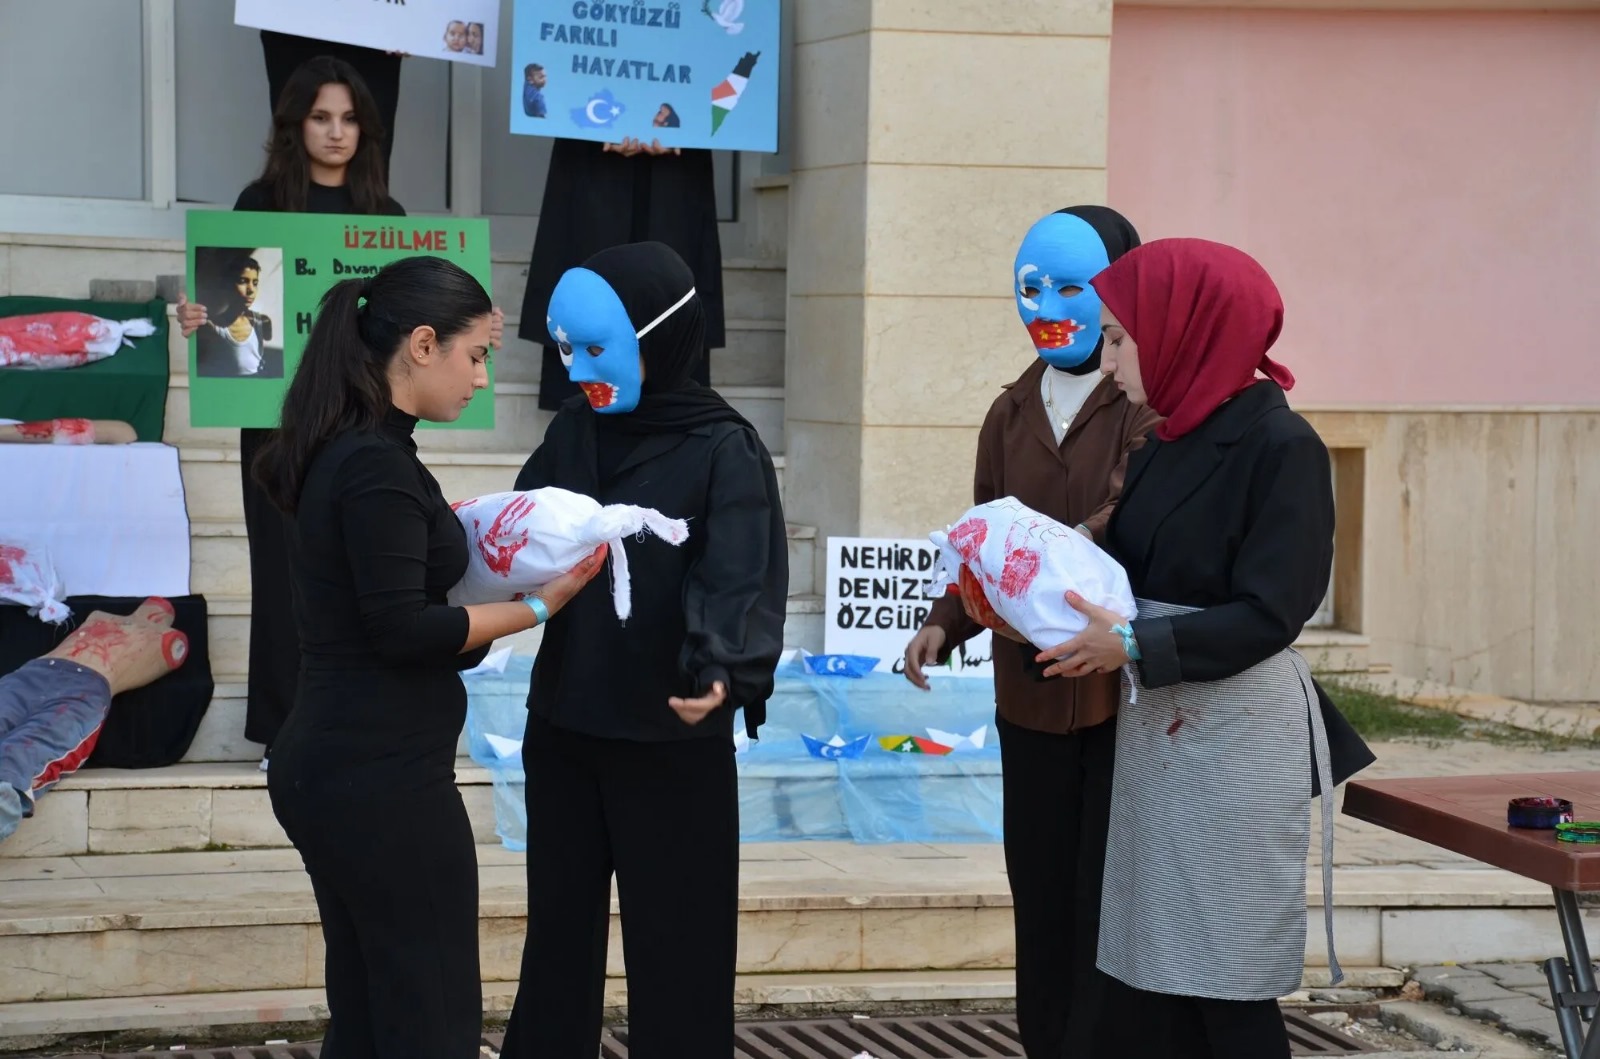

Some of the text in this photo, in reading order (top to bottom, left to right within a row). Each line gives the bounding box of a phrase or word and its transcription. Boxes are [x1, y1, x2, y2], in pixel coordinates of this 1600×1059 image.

[572, 0, 681, 29] GÖKYÜZÜ
[540, 22, 617, 48] FARKLI
[571, 54, 692, 84] HAYATLAR
[344, 225, 447, 251] ÜZÜLME
[295, 258, 384, 276] Bu Davan
[837, 602, 929, 631] ÖZGÜR
